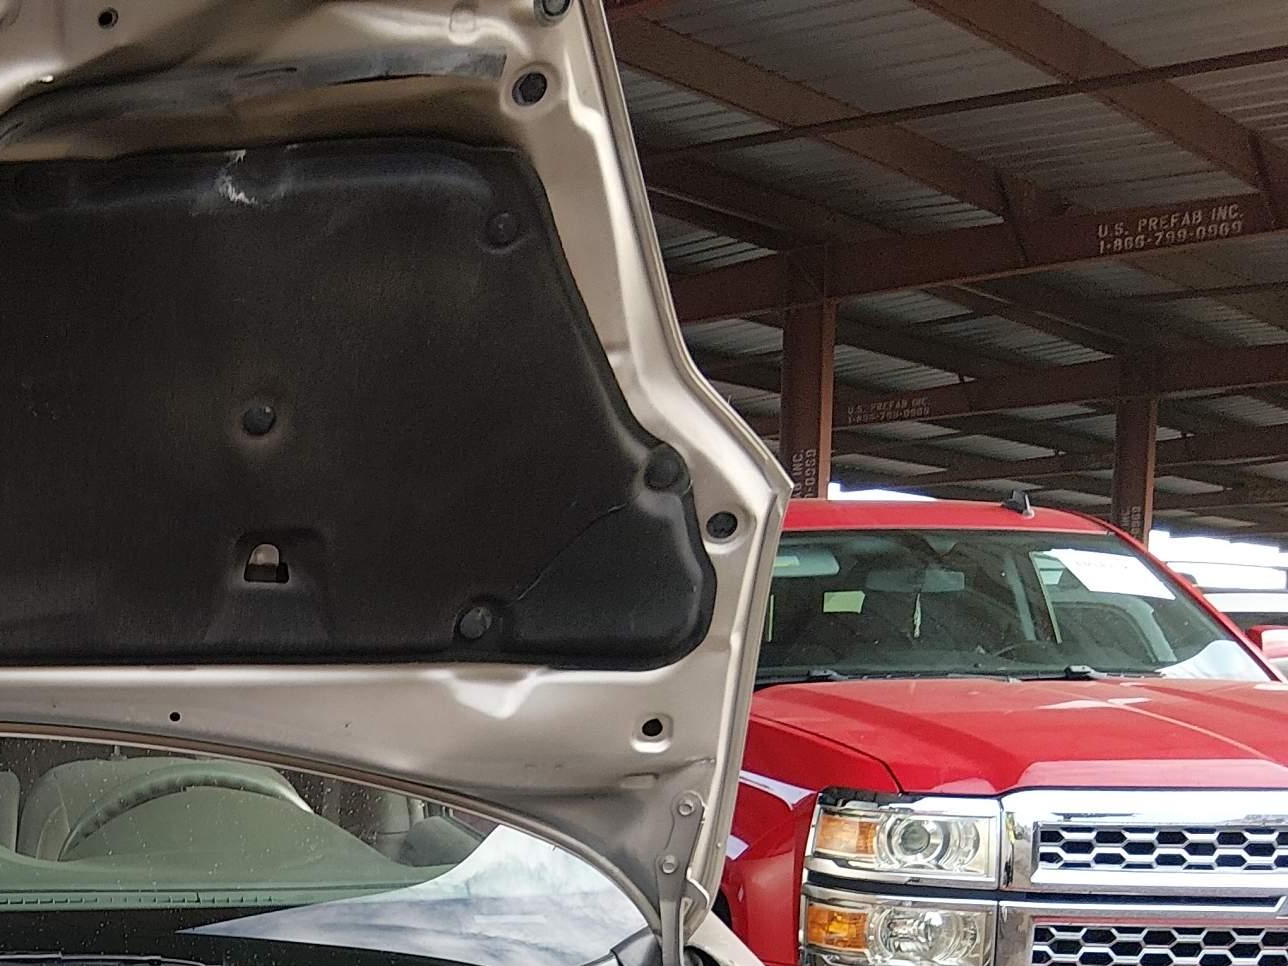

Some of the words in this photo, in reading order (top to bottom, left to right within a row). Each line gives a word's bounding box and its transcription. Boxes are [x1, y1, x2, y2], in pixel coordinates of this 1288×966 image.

[1098, 222, 1129, 238] U.S.
[1138, 209, 1203, 232] PREFAB
[1211, 204, 1244, 221] INC.
